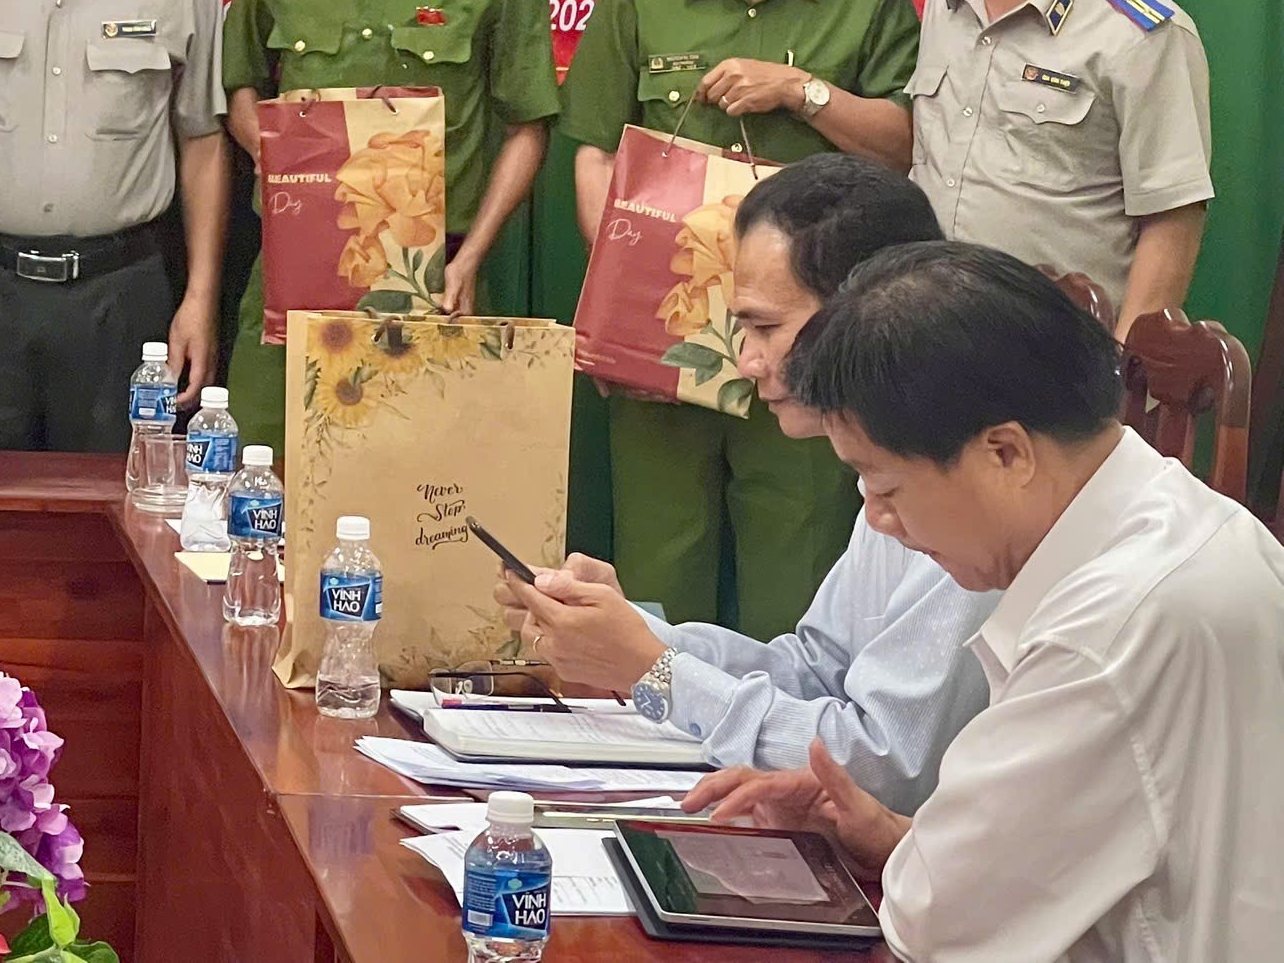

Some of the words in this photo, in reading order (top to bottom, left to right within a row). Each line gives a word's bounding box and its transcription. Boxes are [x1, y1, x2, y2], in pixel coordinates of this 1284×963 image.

[268, 173, 332, 184] BEAUTIFUL
[614, 198, 677, 223] BEAUTIFUL
[416, 483, 463, 504] Never
[416, 499, 466, 522] Stop
[415, 525, 469, 550] dreaming
